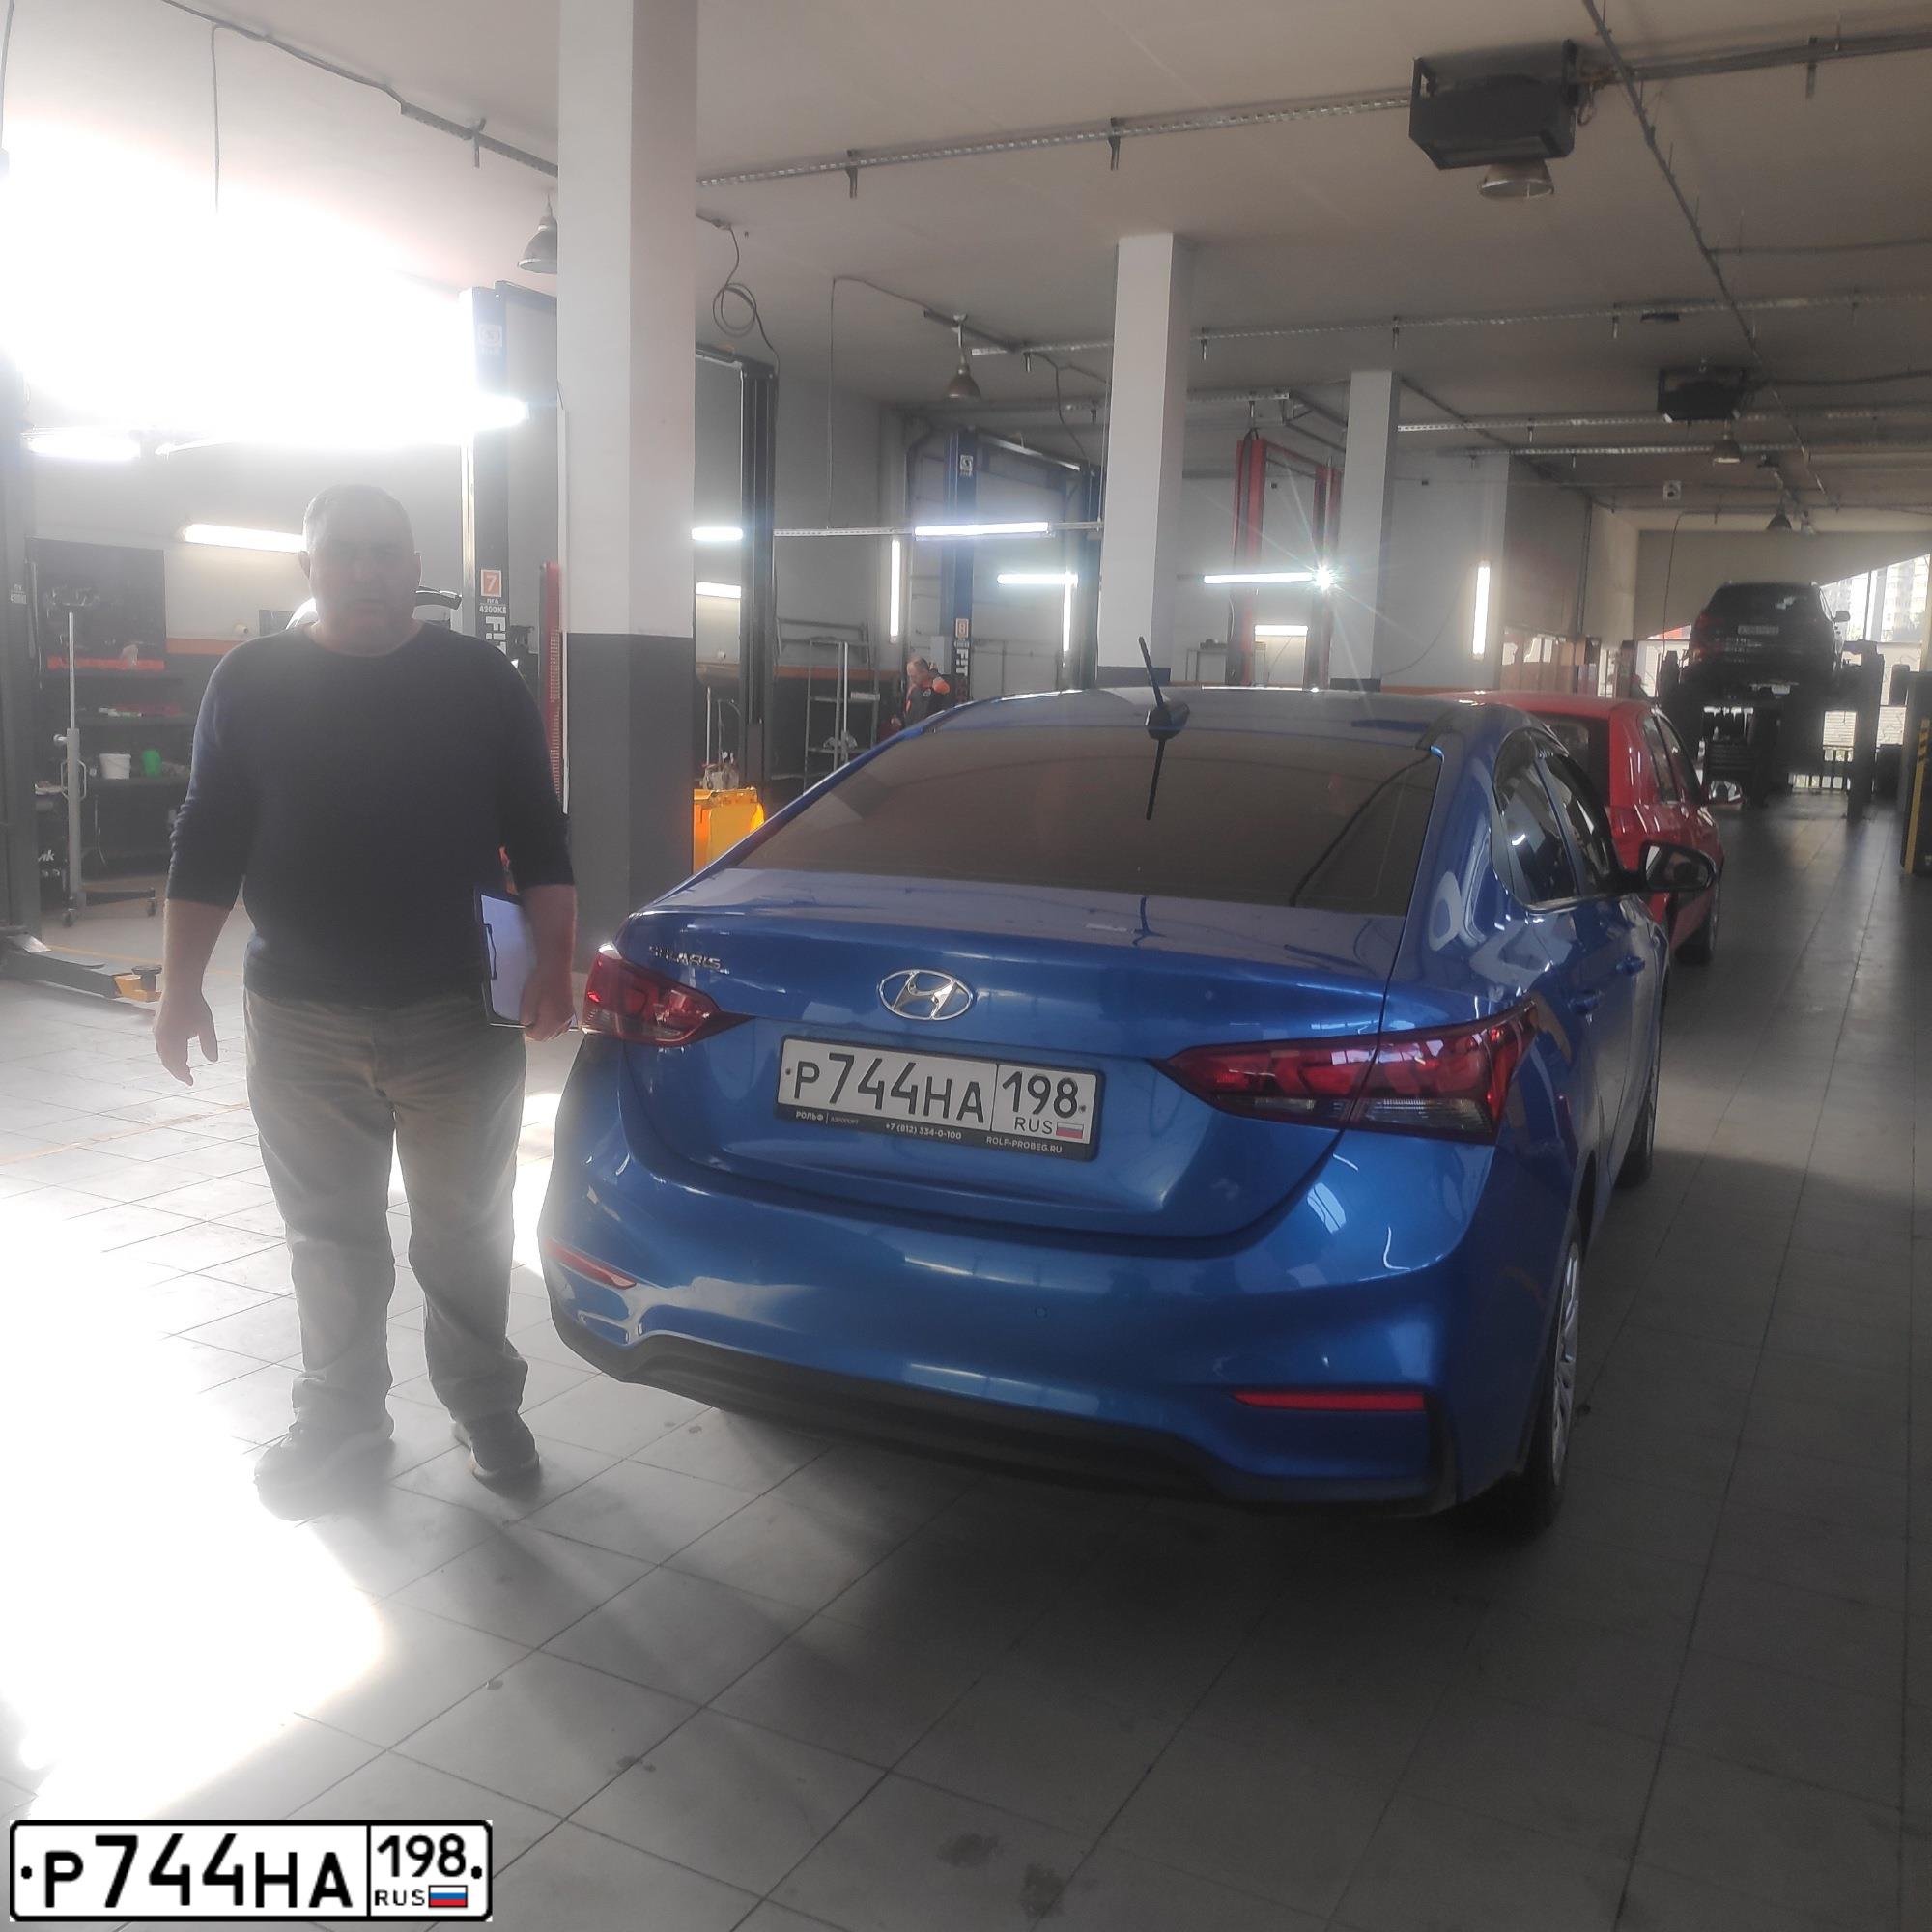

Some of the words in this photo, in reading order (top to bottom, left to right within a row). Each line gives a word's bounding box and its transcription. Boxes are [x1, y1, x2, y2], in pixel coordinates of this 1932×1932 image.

[485, 574, 498, 593] 7
[794, 1052, 984, 1123] Р744НА
[1002, 1070, 1079, 1119] 198
[795, 1110, 824, 1122] РОЛЬФ
[1014, 1117, 1053, 1135] RUS
[986, 1136, 1063, 1153] ROLF-PROBEG.RU
